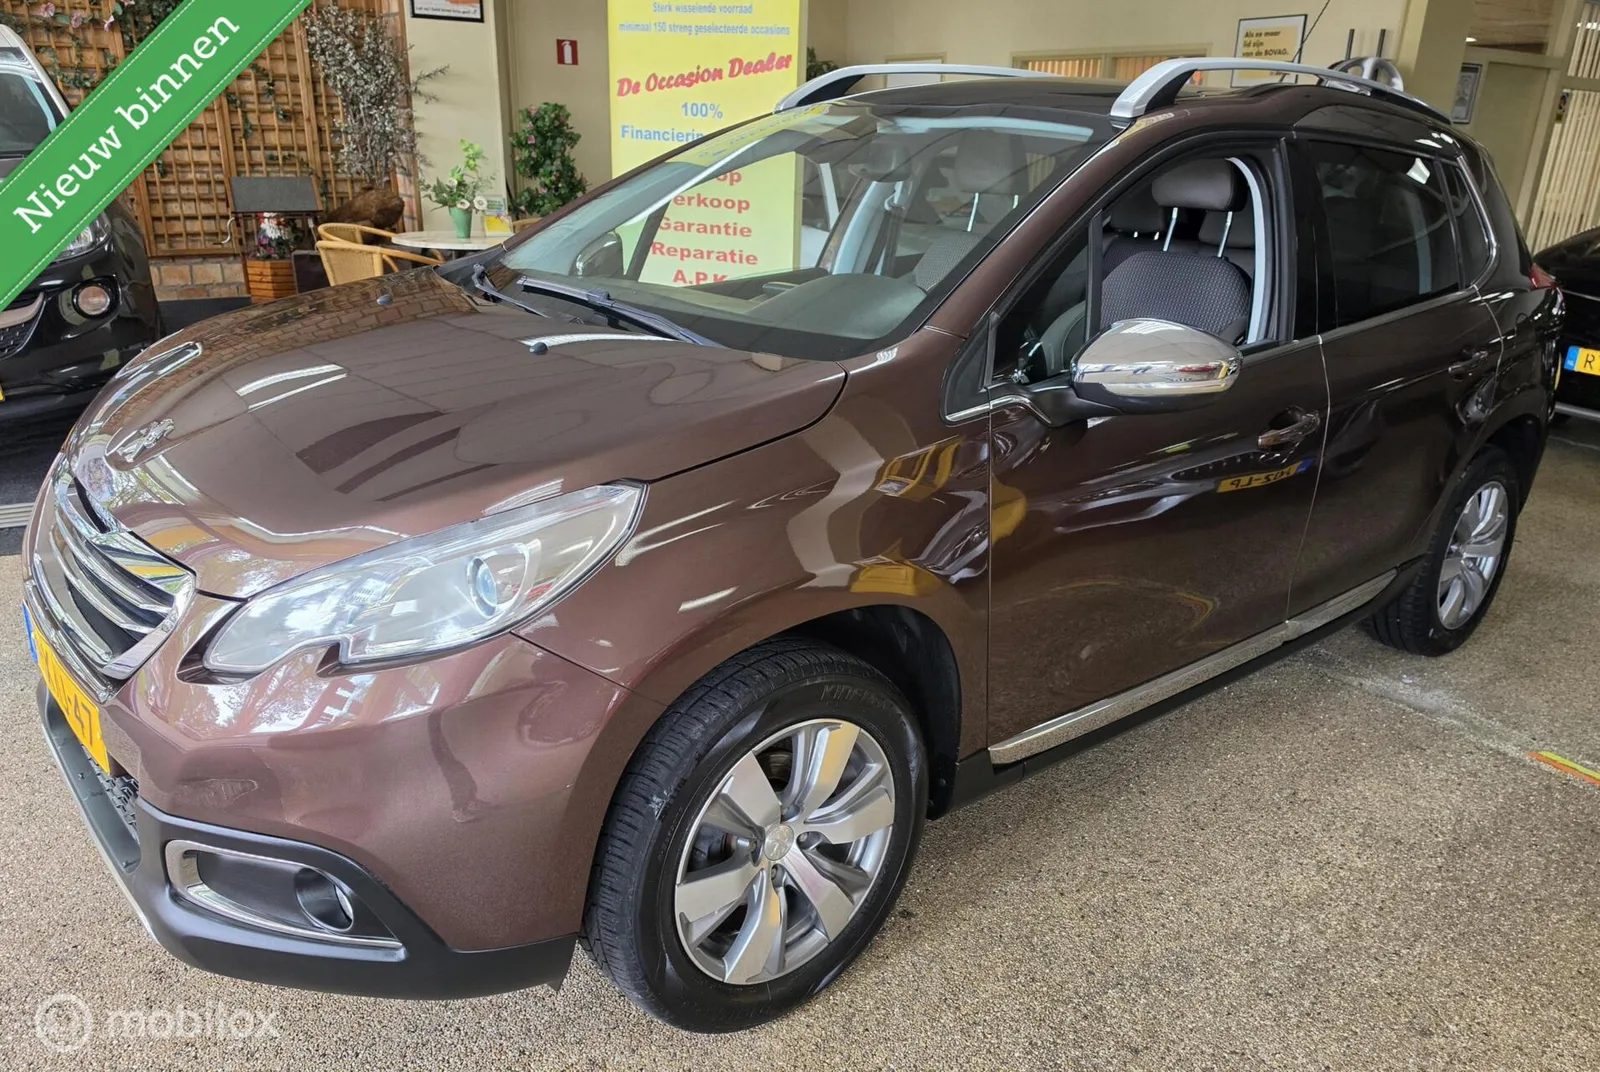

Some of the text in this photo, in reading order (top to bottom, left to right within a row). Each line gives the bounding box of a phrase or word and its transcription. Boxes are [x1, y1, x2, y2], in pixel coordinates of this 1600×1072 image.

[653, 2, 753, 14] Sterk wisselende voorraad
[619, 22, 791, 36] minimaal 150 streng geselecteerde occasions
[616, 52, 793, 97] De Occasion Dealer
[681, 102, 723, 119] 100%
[621, 125, 704, 142] Financierin
[672, 192, 751, 214] erkoop
[651, 241, 758, 266] Reparatie
